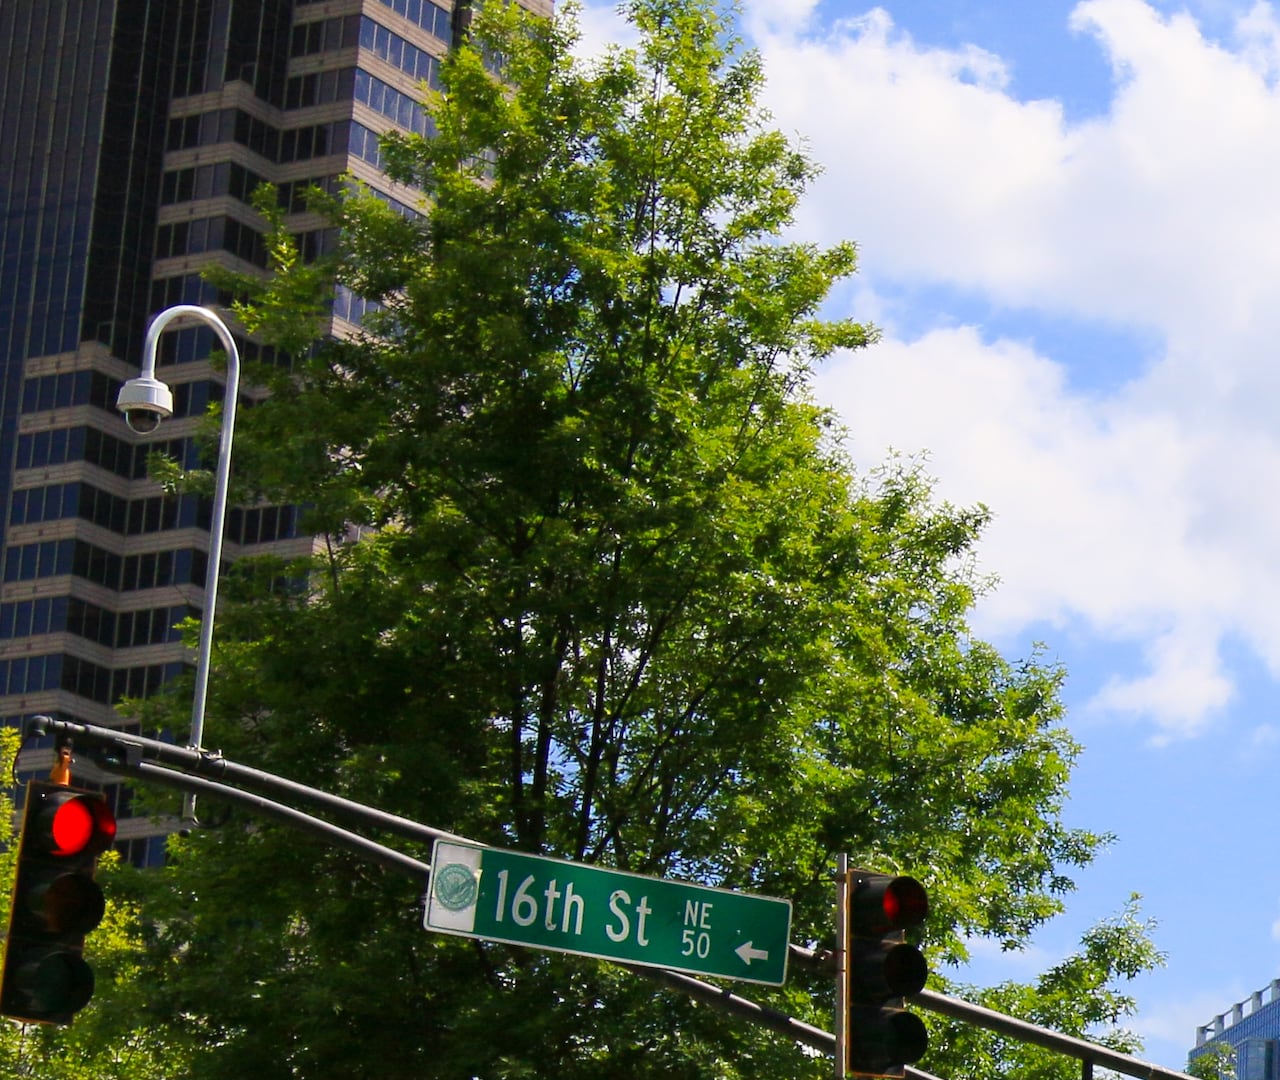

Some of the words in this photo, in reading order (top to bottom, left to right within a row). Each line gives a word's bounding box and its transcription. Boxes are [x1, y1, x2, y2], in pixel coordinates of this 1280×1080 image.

[495, 869, 585, 935] 16th
[605, 889, 652, 947] St
[684, 900, 713, 930] NE
[681, 930, 710, 959] 50
